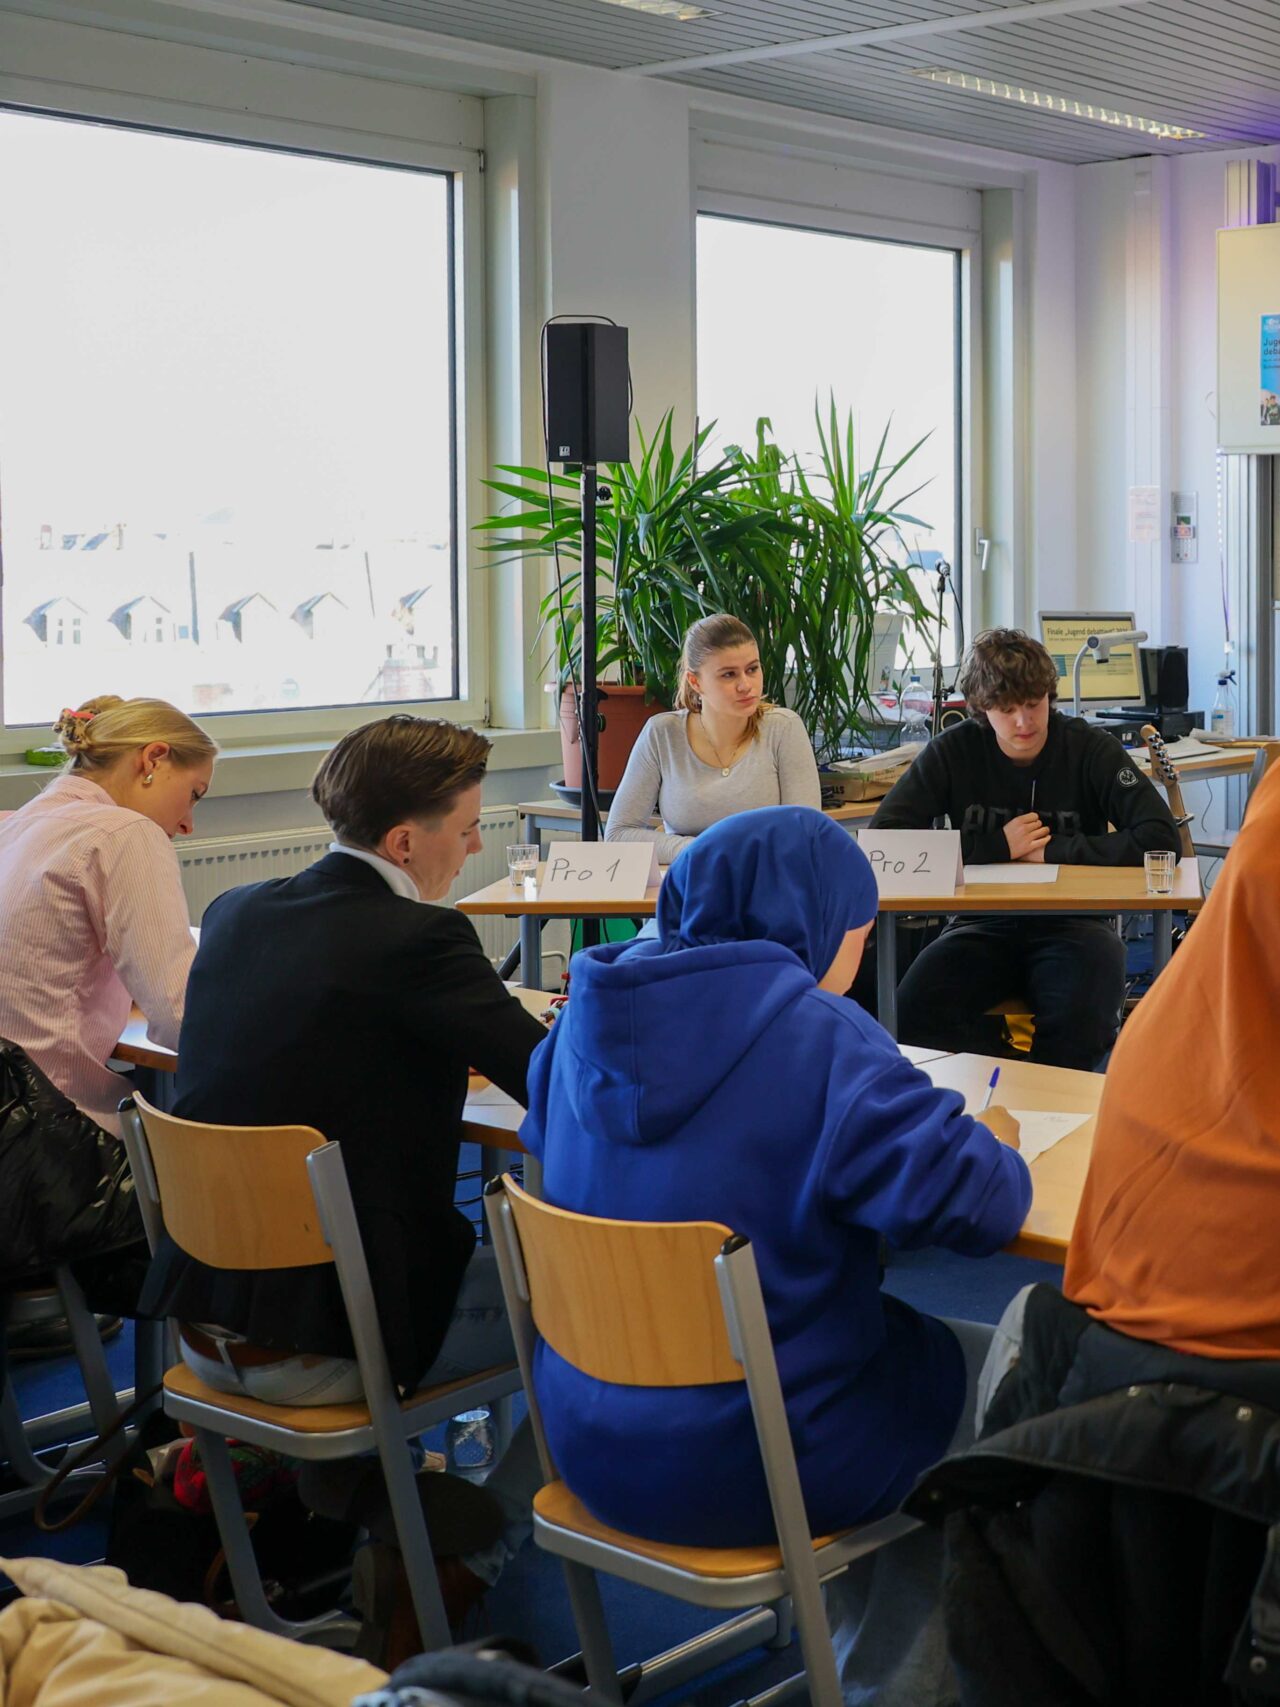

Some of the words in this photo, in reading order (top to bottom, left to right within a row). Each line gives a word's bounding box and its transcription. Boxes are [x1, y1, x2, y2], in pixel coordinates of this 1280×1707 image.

[551, 858, 592, 882] Pro
[606, 858, 620, 882] 1
[868, 850, 905, 875] Pro
[912, 851, 931, 874] 2
